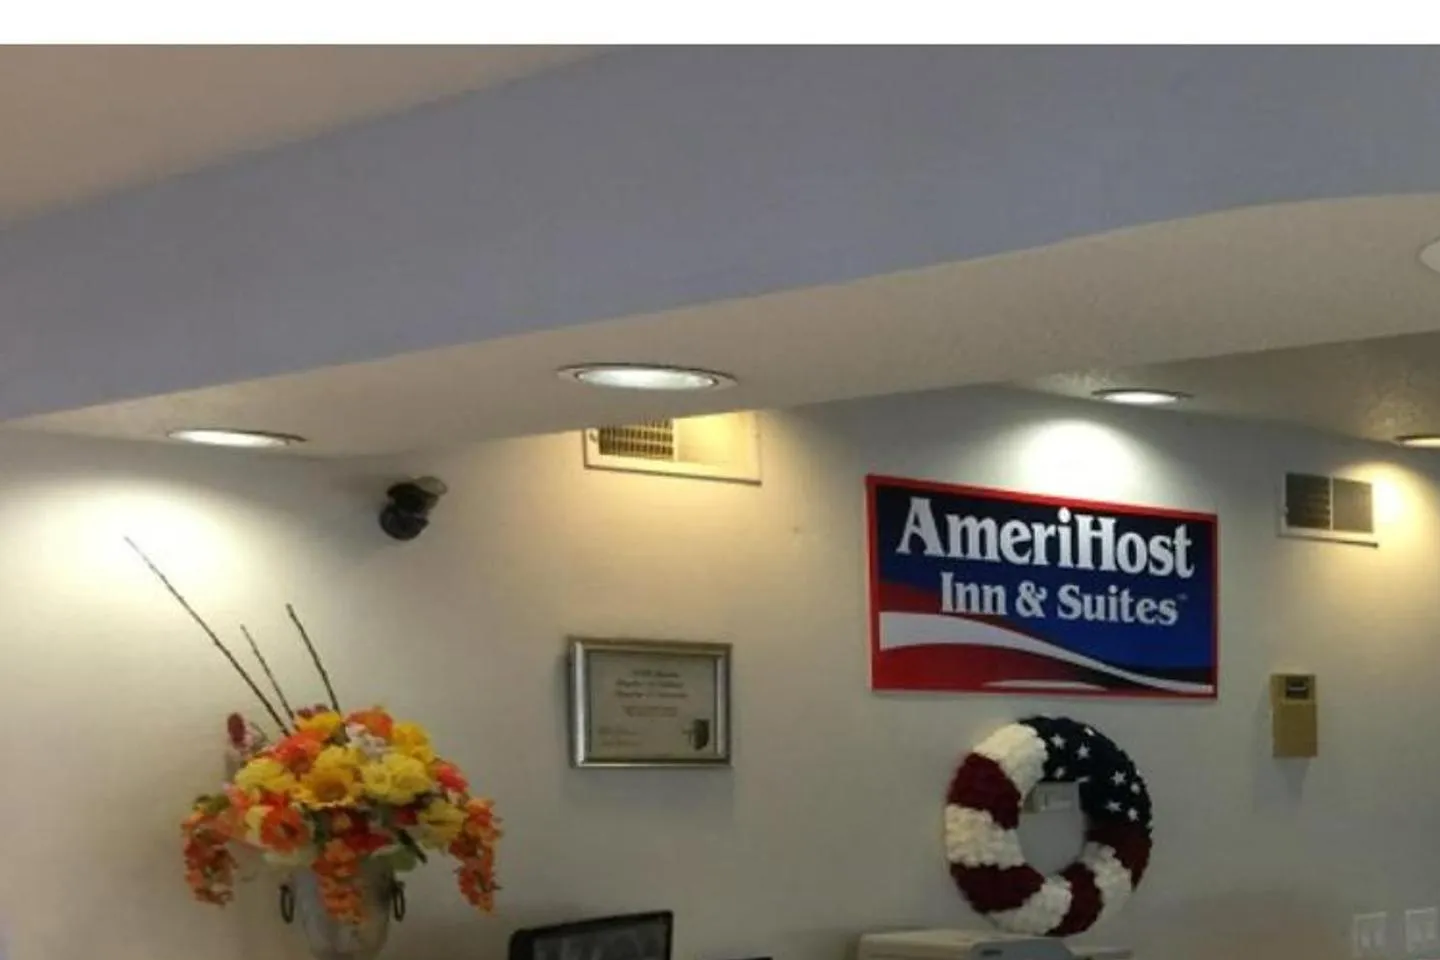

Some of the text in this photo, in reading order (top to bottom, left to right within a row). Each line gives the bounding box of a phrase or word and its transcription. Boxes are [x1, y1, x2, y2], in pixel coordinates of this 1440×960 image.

[896, 496, 1195, 579] AmeriHost
[940, 571, 1179, 626] Inn & Suites
